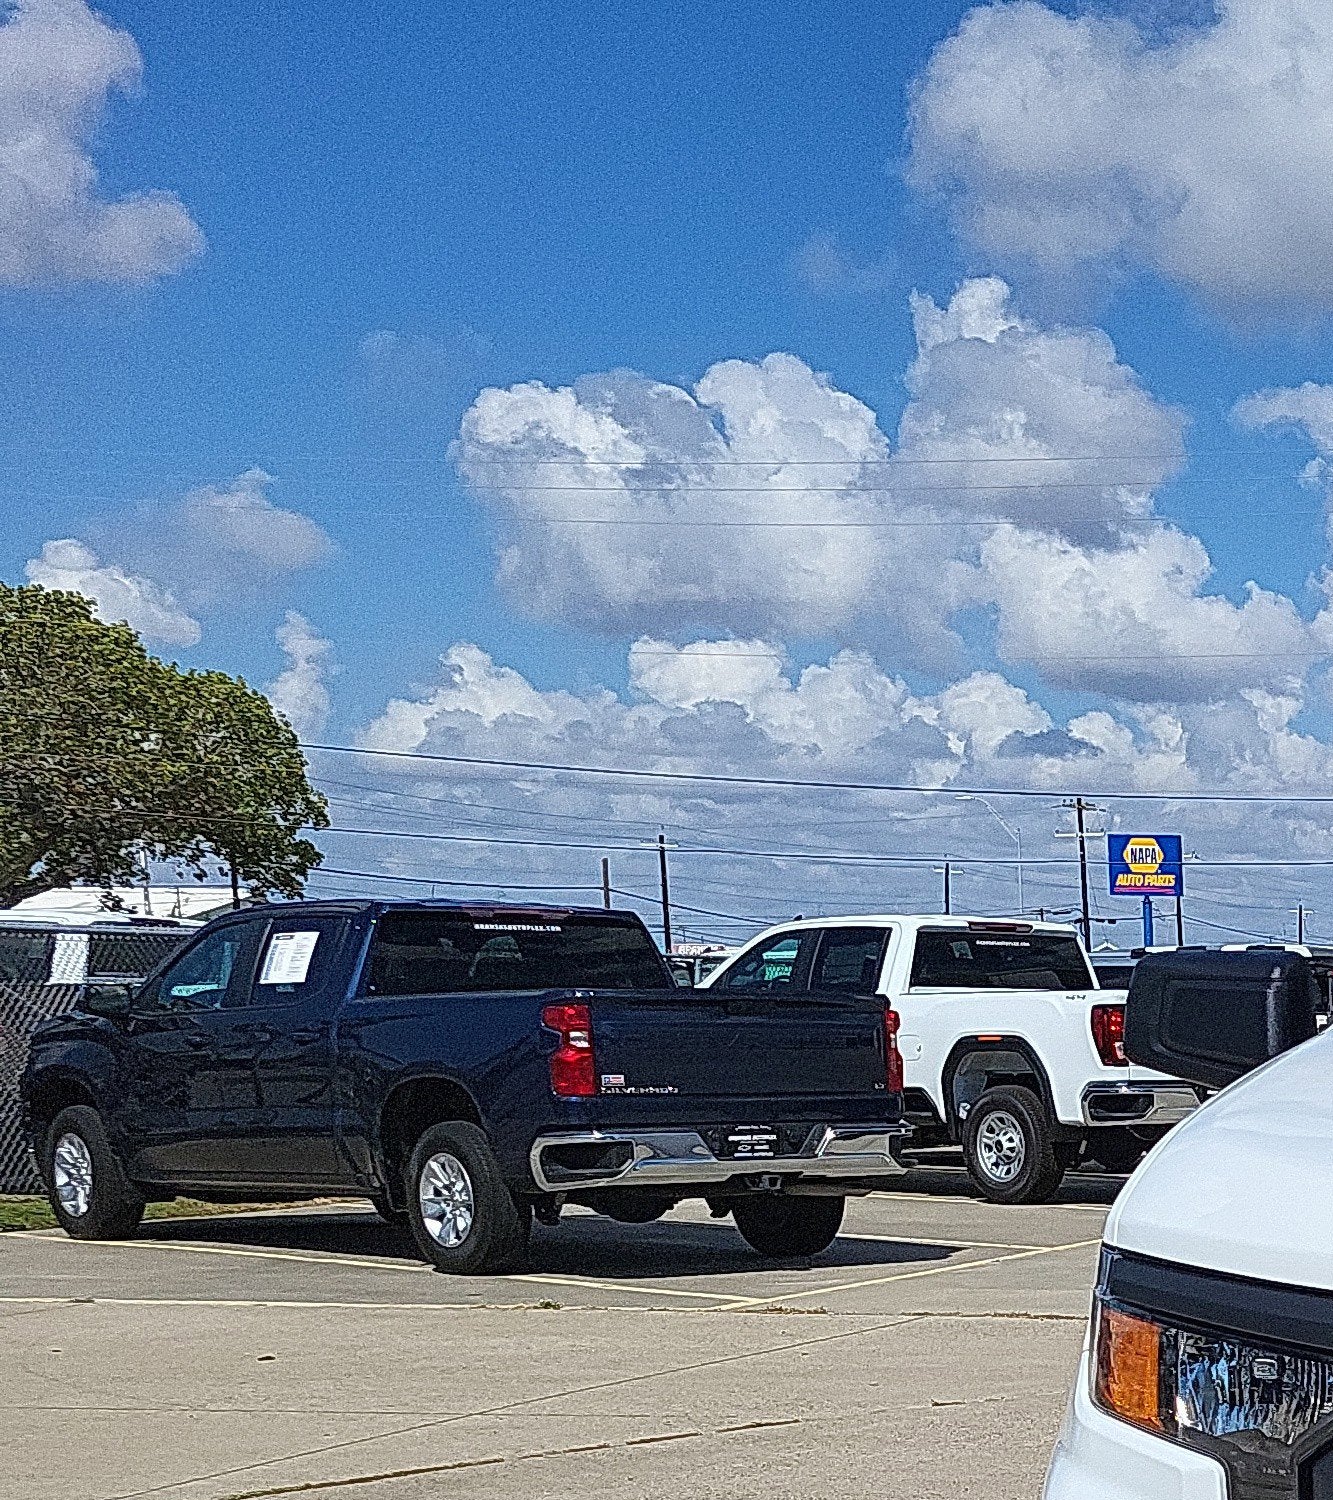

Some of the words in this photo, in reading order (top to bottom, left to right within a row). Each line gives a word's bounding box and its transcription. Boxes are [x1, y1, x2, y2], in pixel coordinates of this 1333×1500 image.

[1130, 848, 1157, 864] NAPA
[1115, 873, 1143, 886] AUTO
[1144, 874, 1176, 887] PARTS
